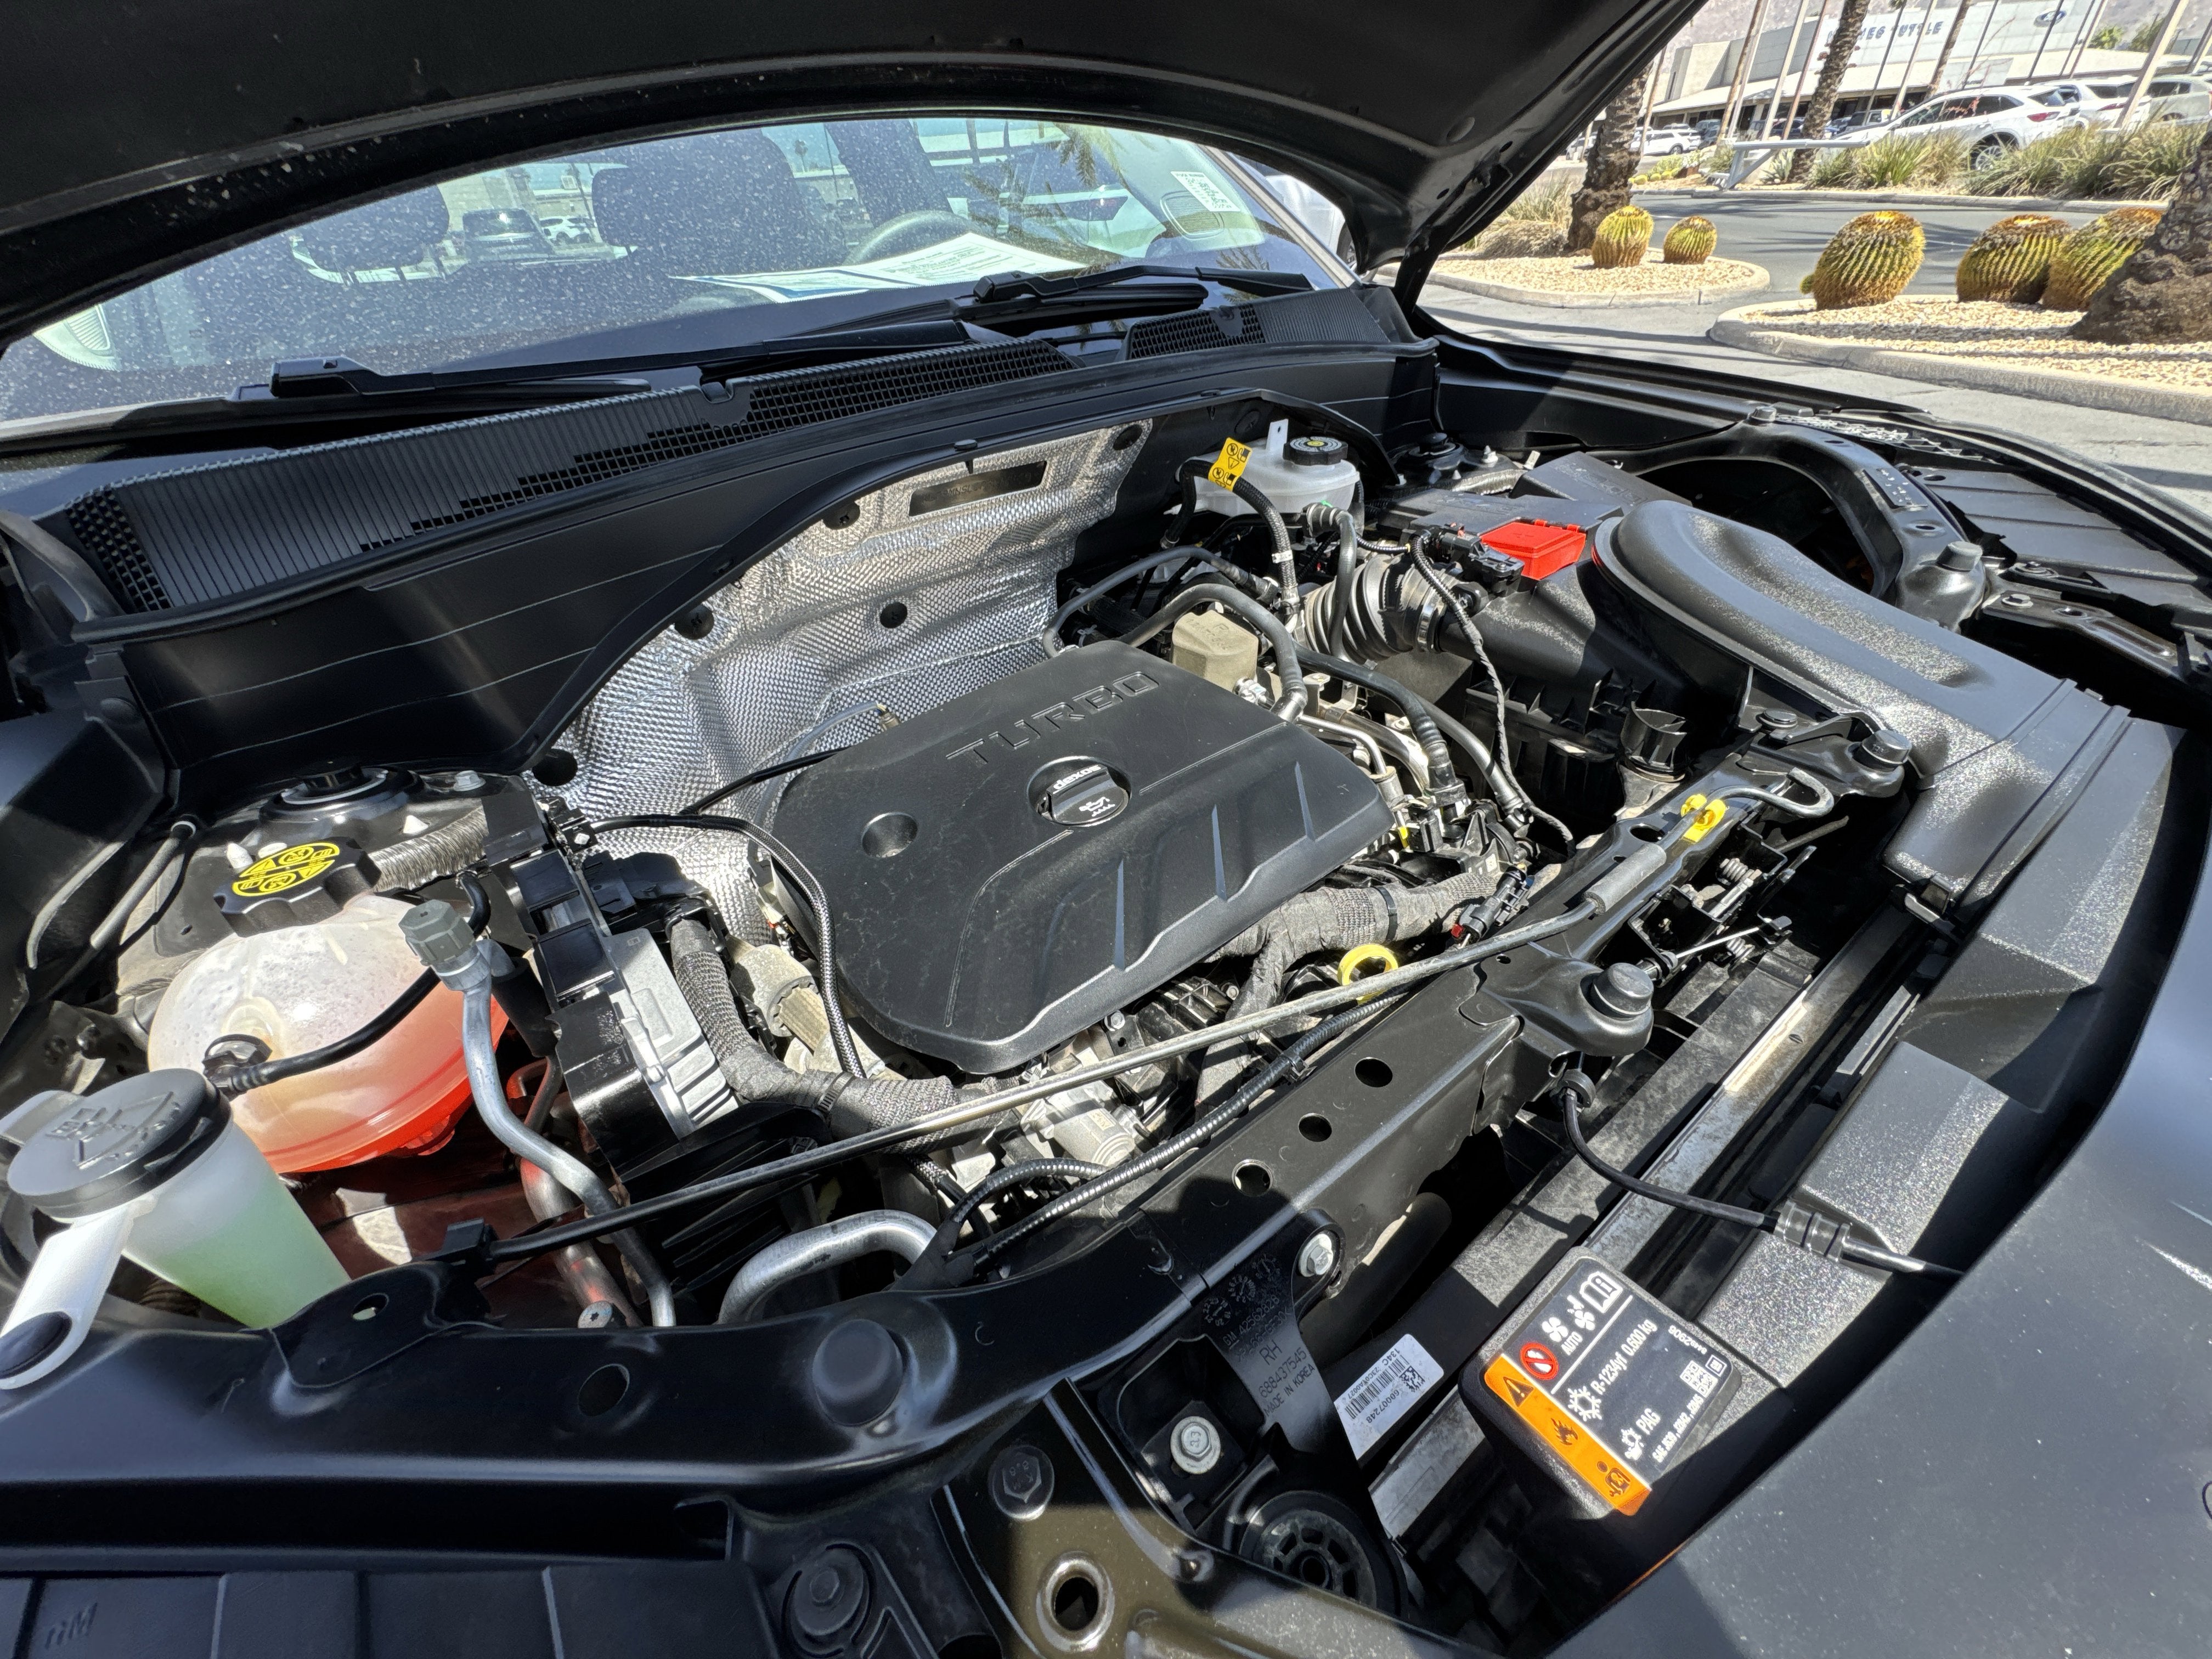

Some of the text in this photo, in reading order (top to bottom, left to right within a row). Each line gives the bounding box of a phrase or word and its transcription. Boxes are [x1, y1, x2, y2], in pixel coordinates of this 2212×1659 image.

[945, 671, 1159, 764] TURBO
[1053, 765, 1102, 791] dexos
[1239, 1294, 1279, 1335] 42562828
[1259, 1339, 1282, 1365] RH
[1381, 1348, 1400, 1365] 134C
[1561, 1331, 1583, 1356] AUTO
[1590, 1319, 1658, 1395] R-1234yf 0.600 kg
[1259, 1347, 1307, 1398] 688437545
[1263, 1363, 1315, 1417] MADE IN KOREA
[1366, 1389, 1400, 1424] 60007248
[1636, 1408, 1661, 1435] PAG
[1652, 1444, 1668, 1463] SAE
